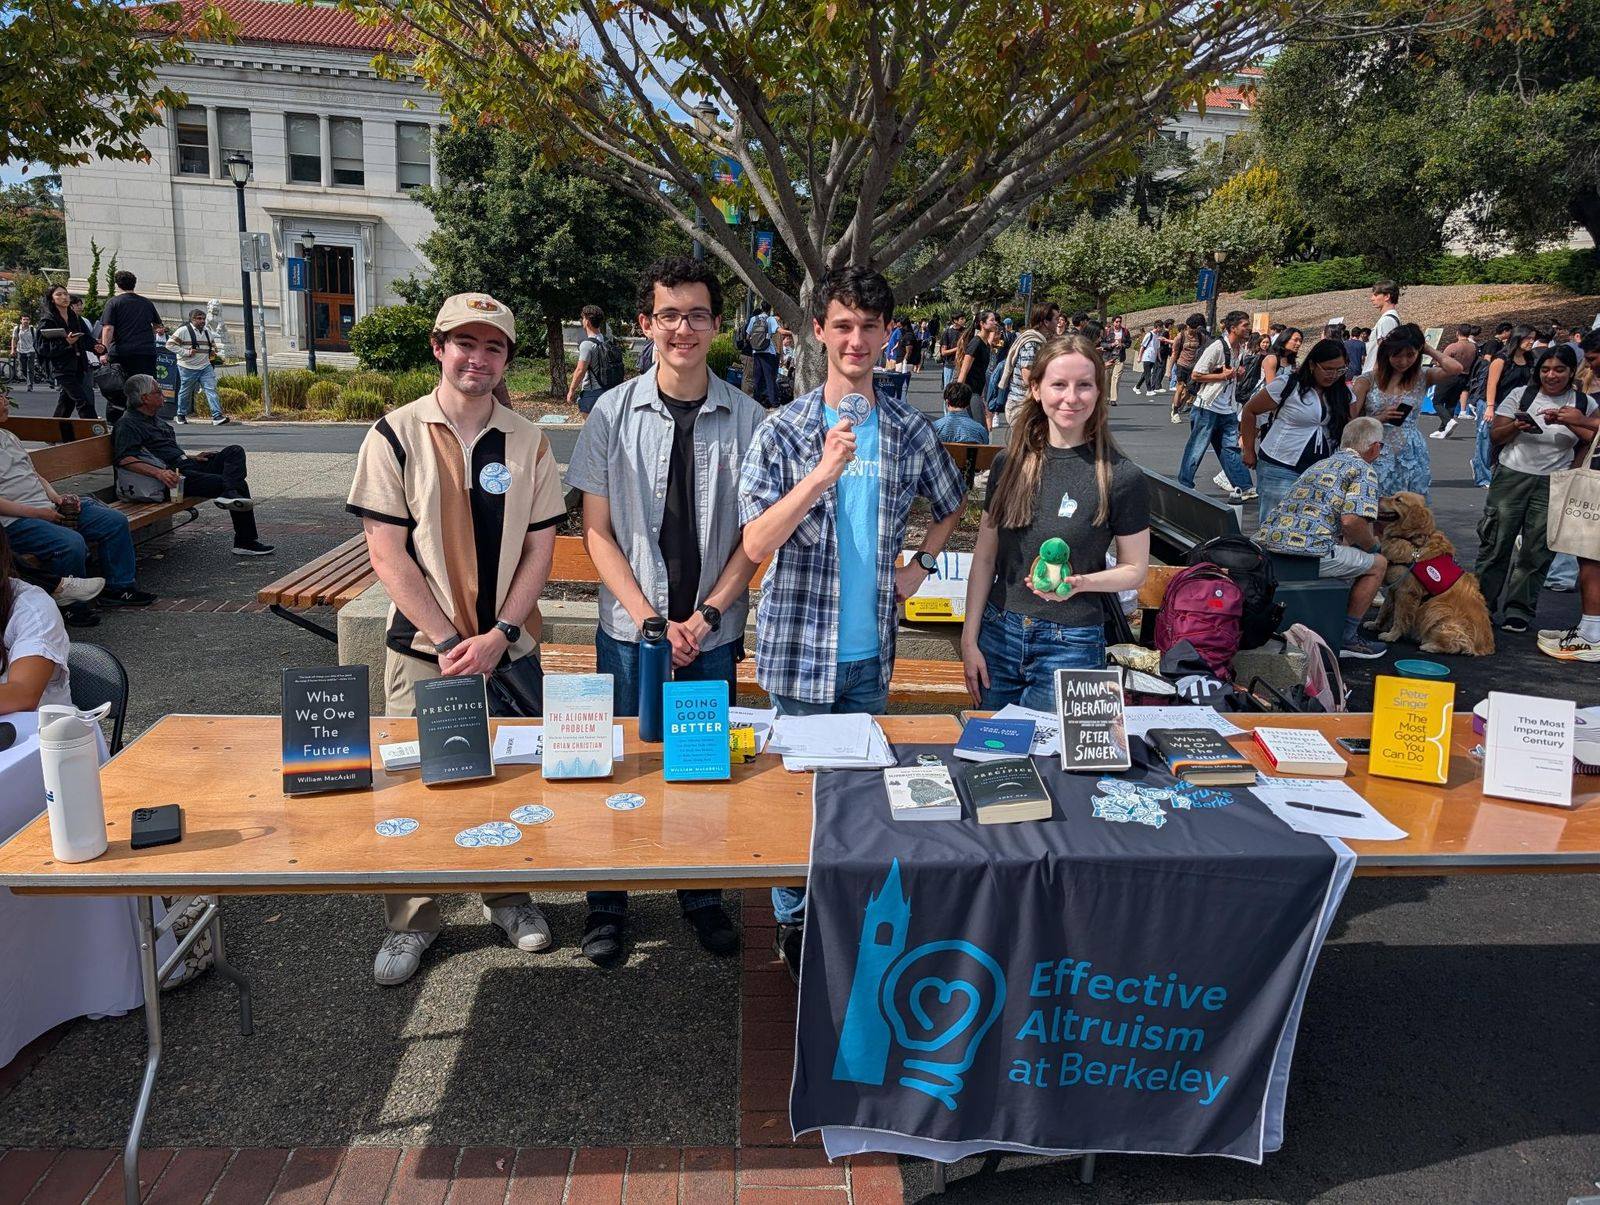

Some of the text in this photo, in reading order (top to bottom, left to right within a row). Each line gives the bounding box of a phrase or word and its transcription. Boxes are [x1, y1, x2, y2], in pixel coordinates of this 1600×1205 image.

[1569, 498, 1600, 511] PUBLI
[1066, 680, 1113, 698] ANIMAL
[1400, 688, 1428, 699] Peter
[307, 691, 344, 703] What
[422, 702, 484, 715] PRECIPICE
[675, 699, 718, 709] DOING
[1064, 699, 1121, 717] LIBERATION
[1393, 697, 1428, 710] Singer
[295, 707, 355, 721] We Owe
[549, 712, 609, 722] THE ALIGNMENT
[677, 711, 716, 720] GOOD
[1407, 713, 1427, 723] The
[671, 722, 722, 733] BETTER
[1400, 722, 1426, 733] Most
[1517, 716, 1565, 728] The Most
[311, 726, 339, 738] The
[560, 724, 596, 733] PROBLEM
[1513, 726, 1565, 738] Important
[1080, 730, 1110, 744] PETER
[1394, 731, 1426, 743] Good
[1522, 736, 1565, 749] Century
[303, 744, 350, 757] Future
[571, 741, 603, 749] CHRISTIAN
[1403, 742, 1425, 752] You
[1074, 744, 1118, 761] SINGER
[1383, 748, 1424, 762] Can Do
[974, 768, 1032, 779] PRECIPICE
[1029, 958, 1228, 1011] Effective
[1015, 1006, 1205, 1051] Altruism
[1008, 1052, 1230, 1106] at Berkeley
